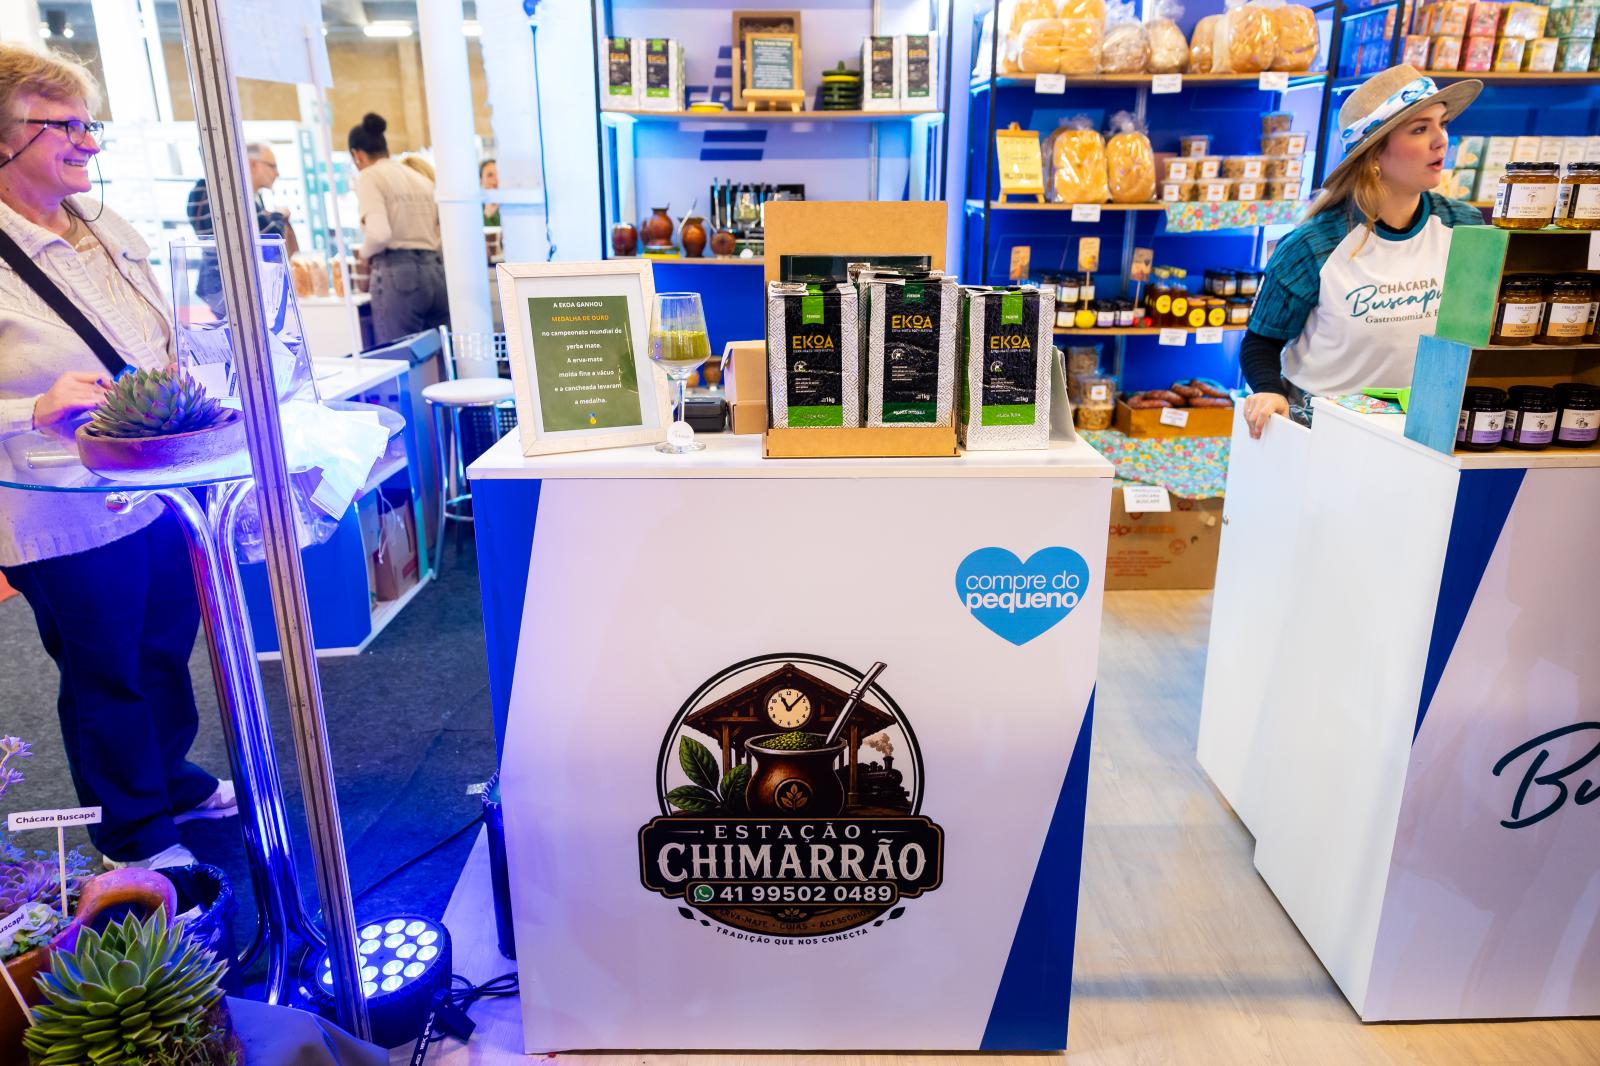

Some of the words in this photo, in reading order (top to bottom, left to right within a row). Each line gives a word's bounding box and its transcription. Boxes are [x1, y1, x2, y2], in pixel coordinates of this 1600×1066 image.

[892, 315, 933, 328] EKOA
[1365, 311, 1423, 324] Gastronomia
[551, 330, 588, 338] campeonato
[792, 334, 834, 349] EKOA
[990, 335, 1031, 349] EKOA
[564, 384, 597, 392] cancheada
[966, 574, 1046, 594] compre
[1052, 570, 1080, 589] do
[966, 592, 1079, 614] pequeno
[16, 815, 54, 824] Chácara
[57, 811, 96, 822] Buscapé
[715, 822, 861, 842] ESTAÇÃO
[656, 838, 926, 882] CHIMARRÃO
[720, 886, 744, 902] 41
[751, 886, 826, 902] 99502
[833, 886, 892, 902] 0489
[716, 926, 770, 944] TRADIÇÃO
[822, 928, 868, 944] CONECTA
